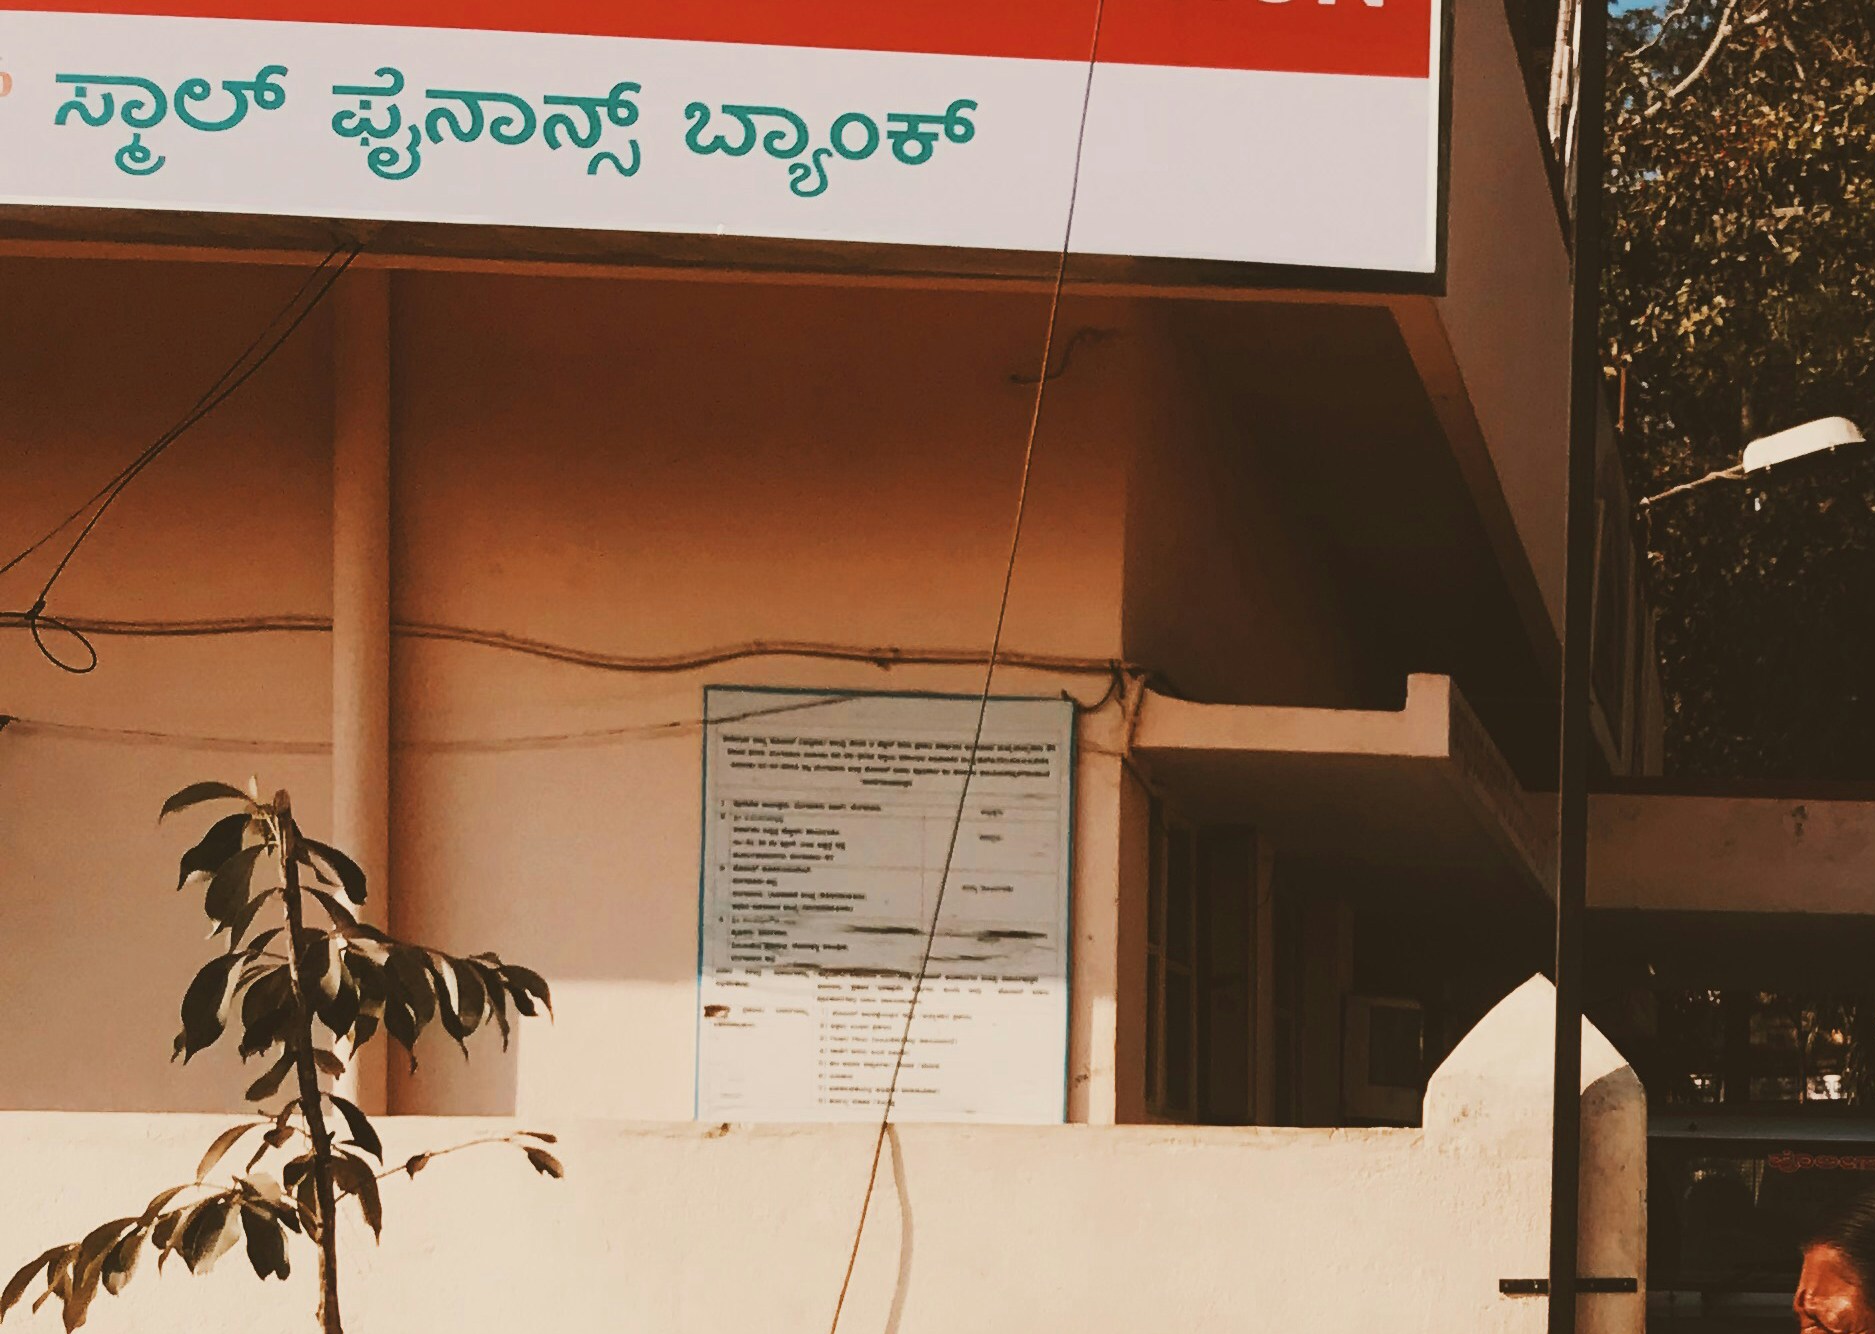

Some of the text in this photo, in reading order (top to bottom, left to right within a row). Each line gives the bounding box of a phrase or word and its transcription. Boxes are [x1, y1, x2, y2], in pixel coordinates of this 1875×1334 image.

[54, 64, 978, 198] ಸ್ಮಾಲ್ ಫೈನಾನ್ಸ್ ಬ್ಯಾಂಕ್
